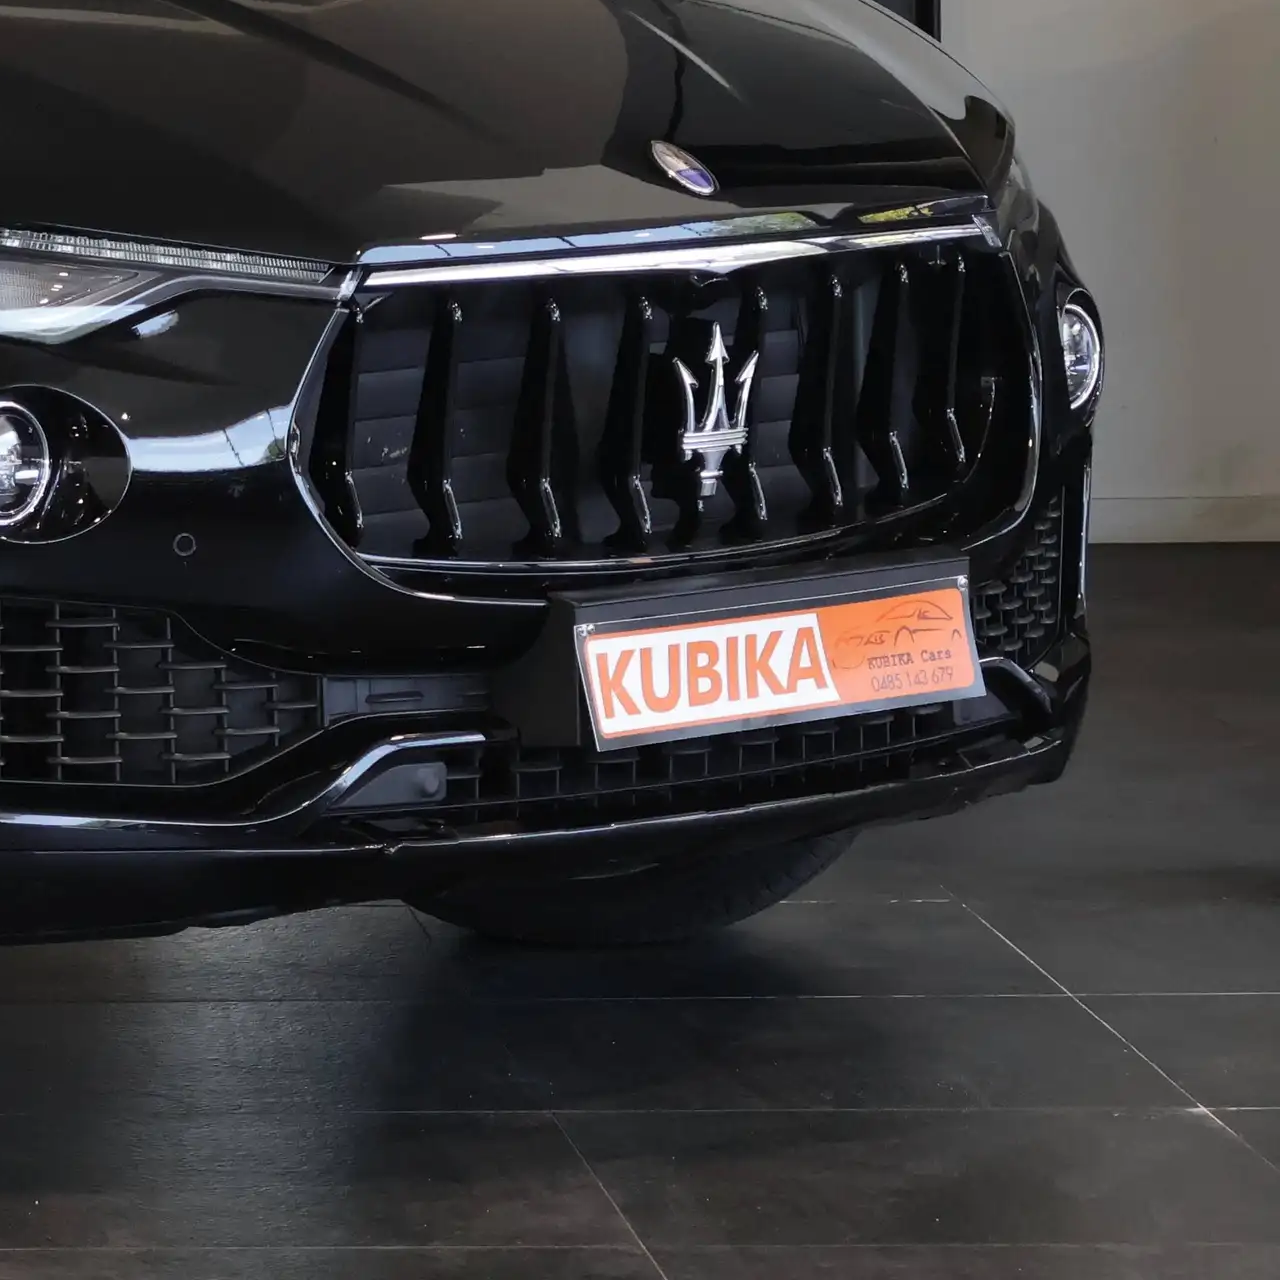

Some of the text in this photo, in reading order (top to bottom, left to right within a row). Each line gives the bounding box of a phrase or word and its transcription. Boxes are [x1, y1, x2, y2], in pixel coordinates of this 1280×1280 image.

[596, 626, 828, 719] KUBIKA
[867, 649, 951, 669] KUBIKA Cars
